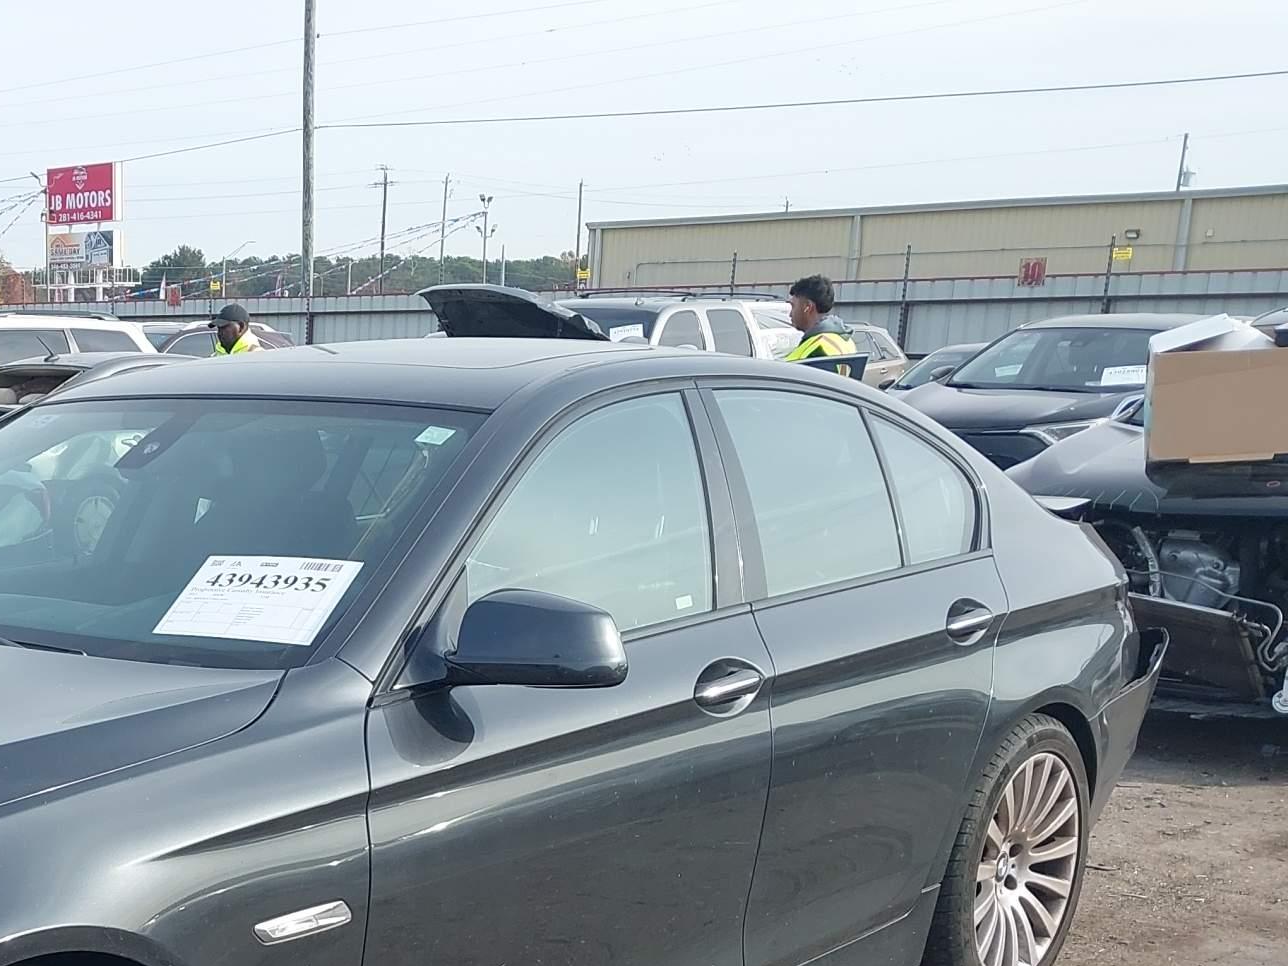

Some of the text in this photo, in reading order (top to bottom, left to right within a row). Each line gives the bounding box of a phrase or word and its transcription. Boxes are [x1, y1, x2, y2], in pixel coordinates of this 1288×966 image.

[50, 190, 111, 210] JB MOTORS
[58, 211, 102, 222] 281-416-4341
[206, 572, 331, 593] 43943935
